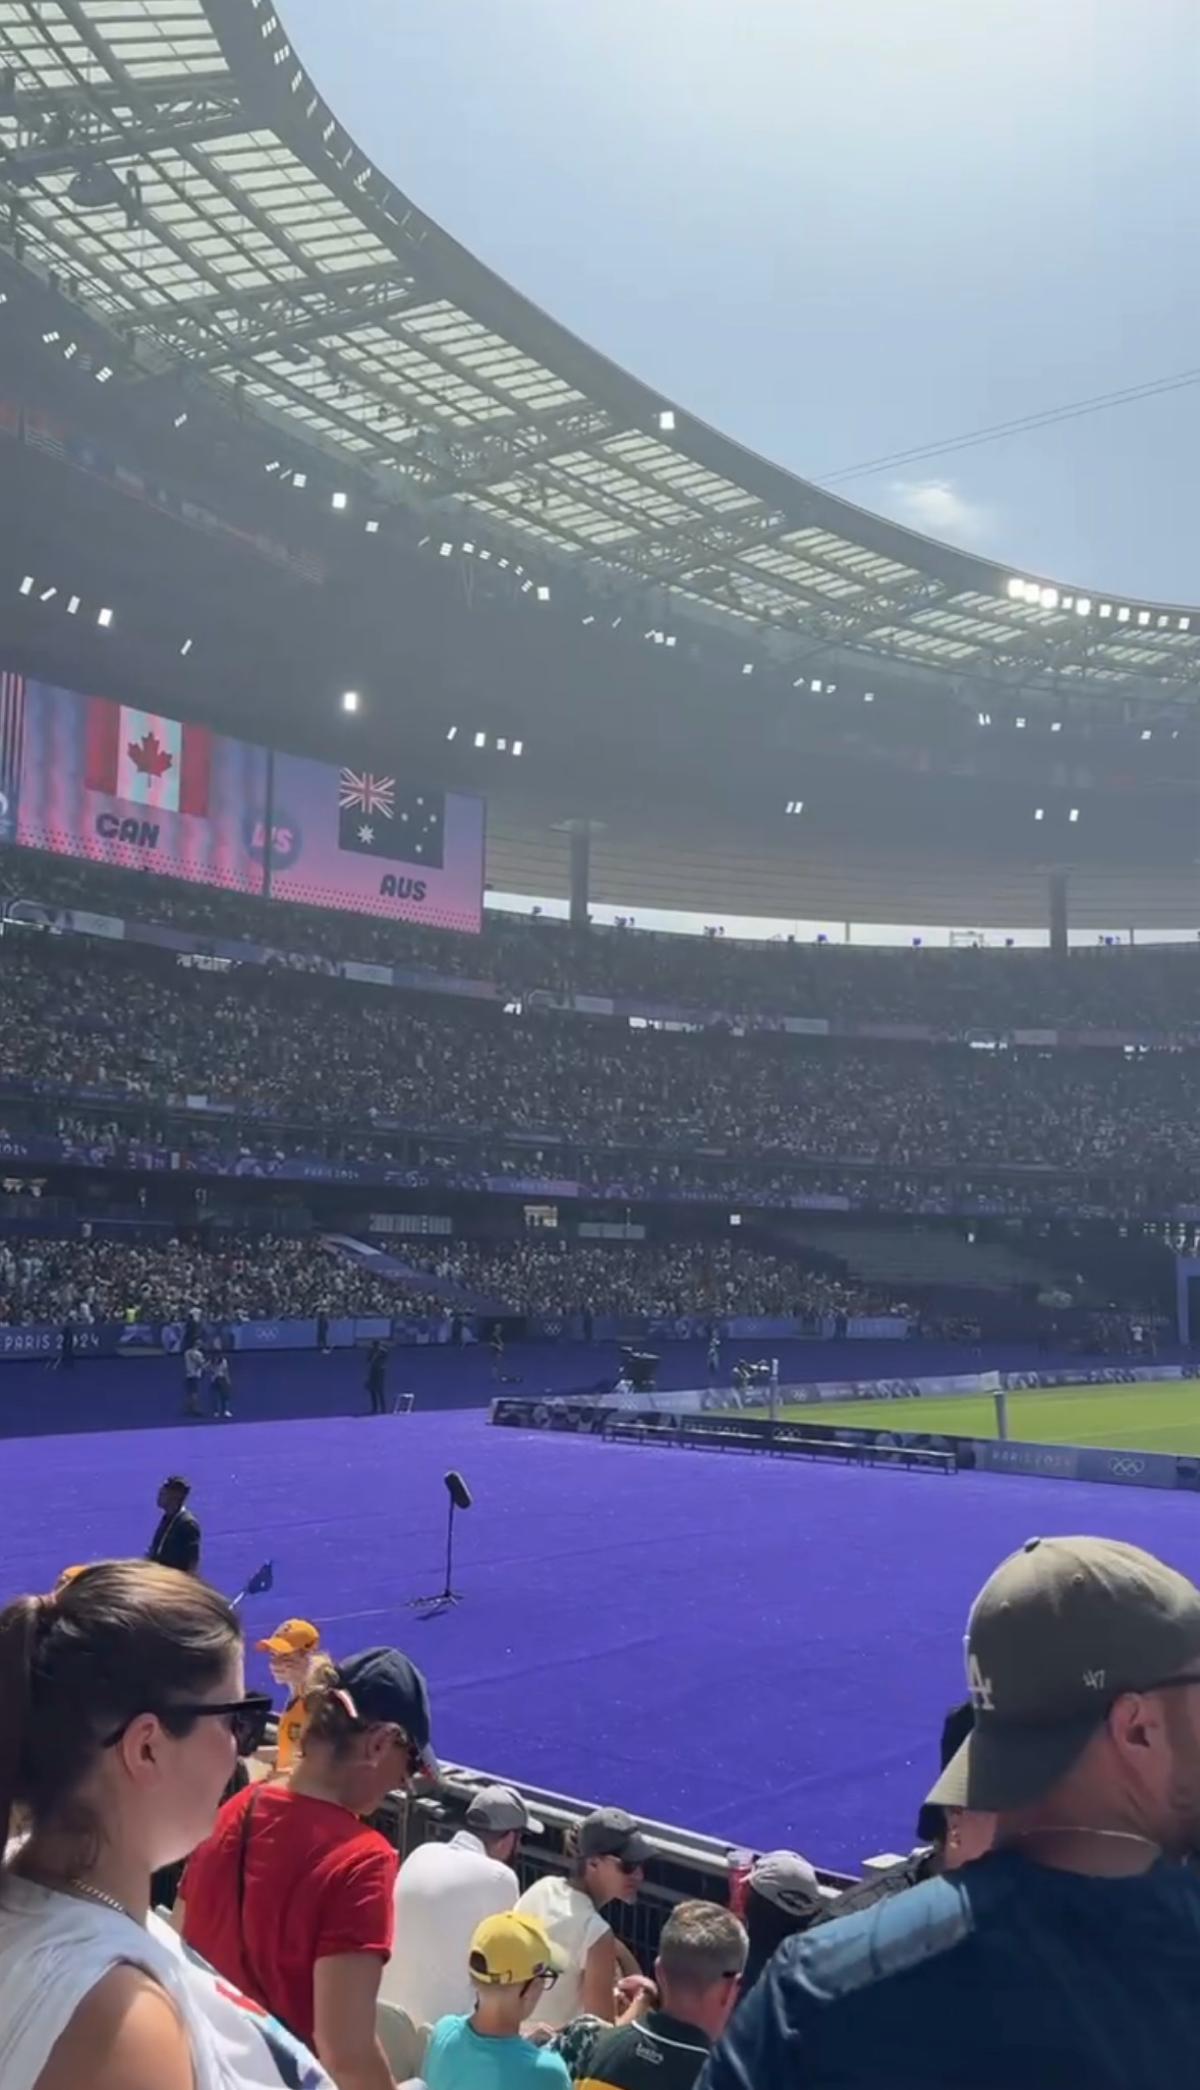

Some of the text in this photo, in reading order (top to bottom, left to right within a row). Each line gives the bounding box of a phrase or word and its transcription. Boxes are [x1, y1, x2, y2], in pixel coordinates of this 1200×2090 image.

[96, 813, 160, 848] CAN
[380, 874, 427, 902] AUS
[0, 1143, 28, 1156] 024
[4, 1334, 51, 1351] PARIS
